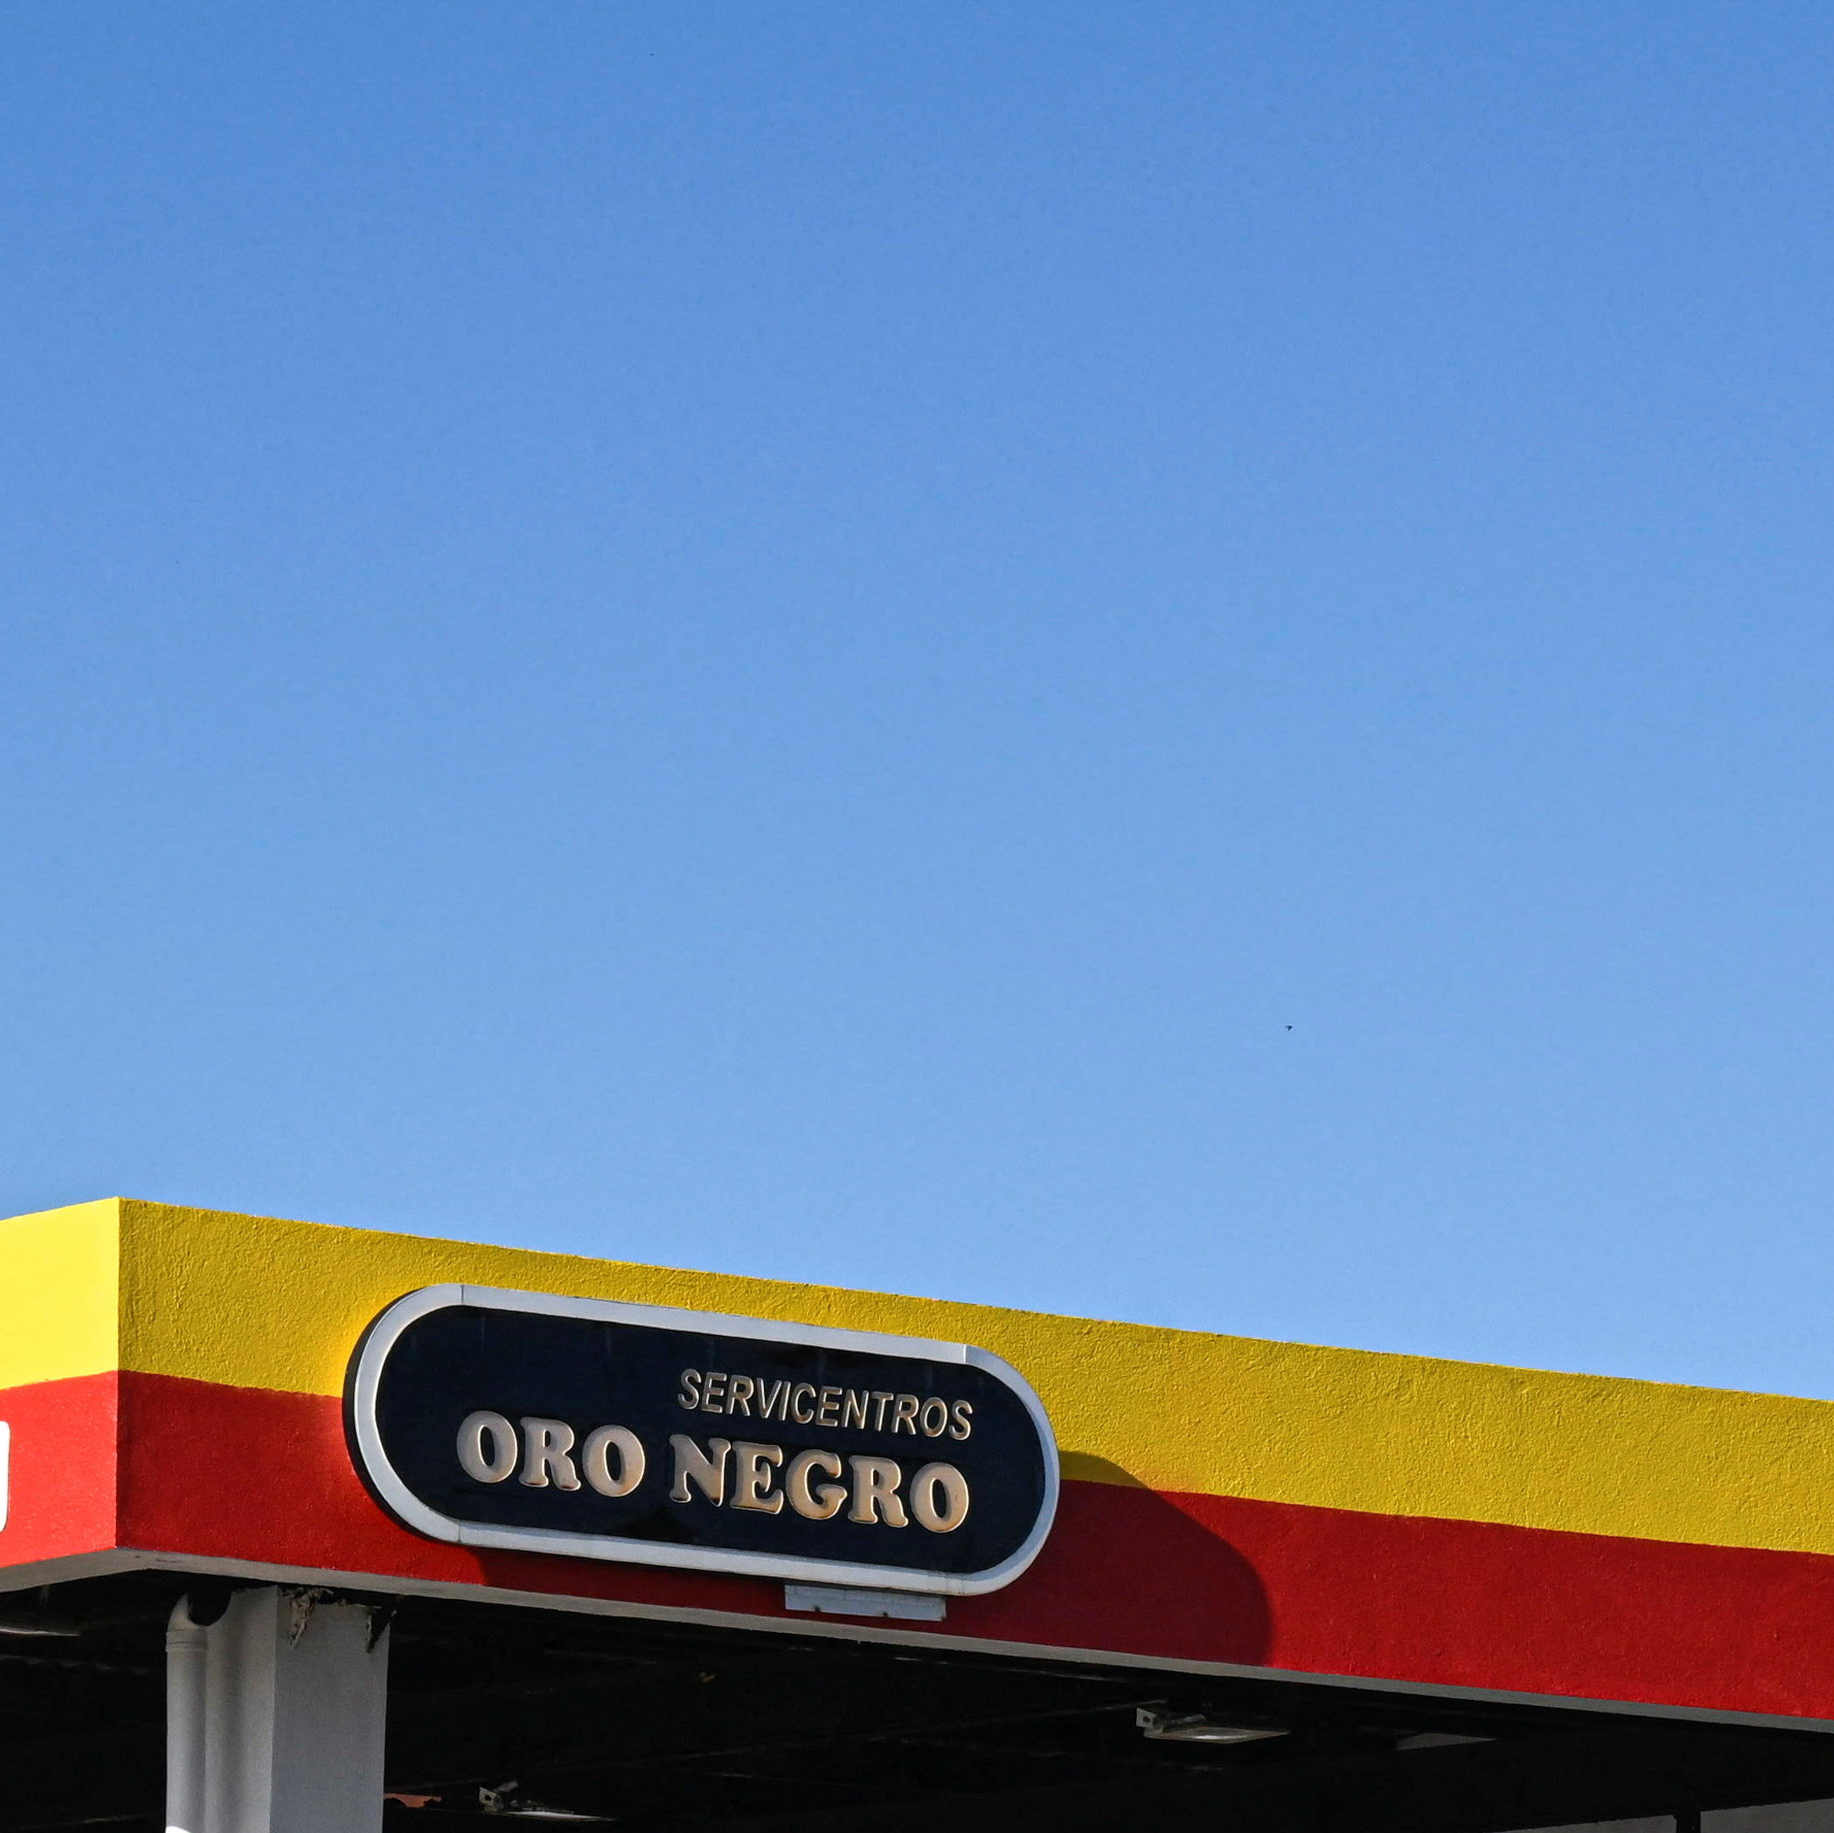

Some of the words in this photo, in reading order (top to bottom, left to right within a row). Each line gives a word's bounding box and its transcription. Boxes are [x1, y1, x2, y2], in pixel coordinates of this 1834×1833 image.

[677, 1367, 973, 1442] SERVICENTROS
[456, 1410, 646, 1498] ORO
[668, 1434, 970, 1534] NEGRO
